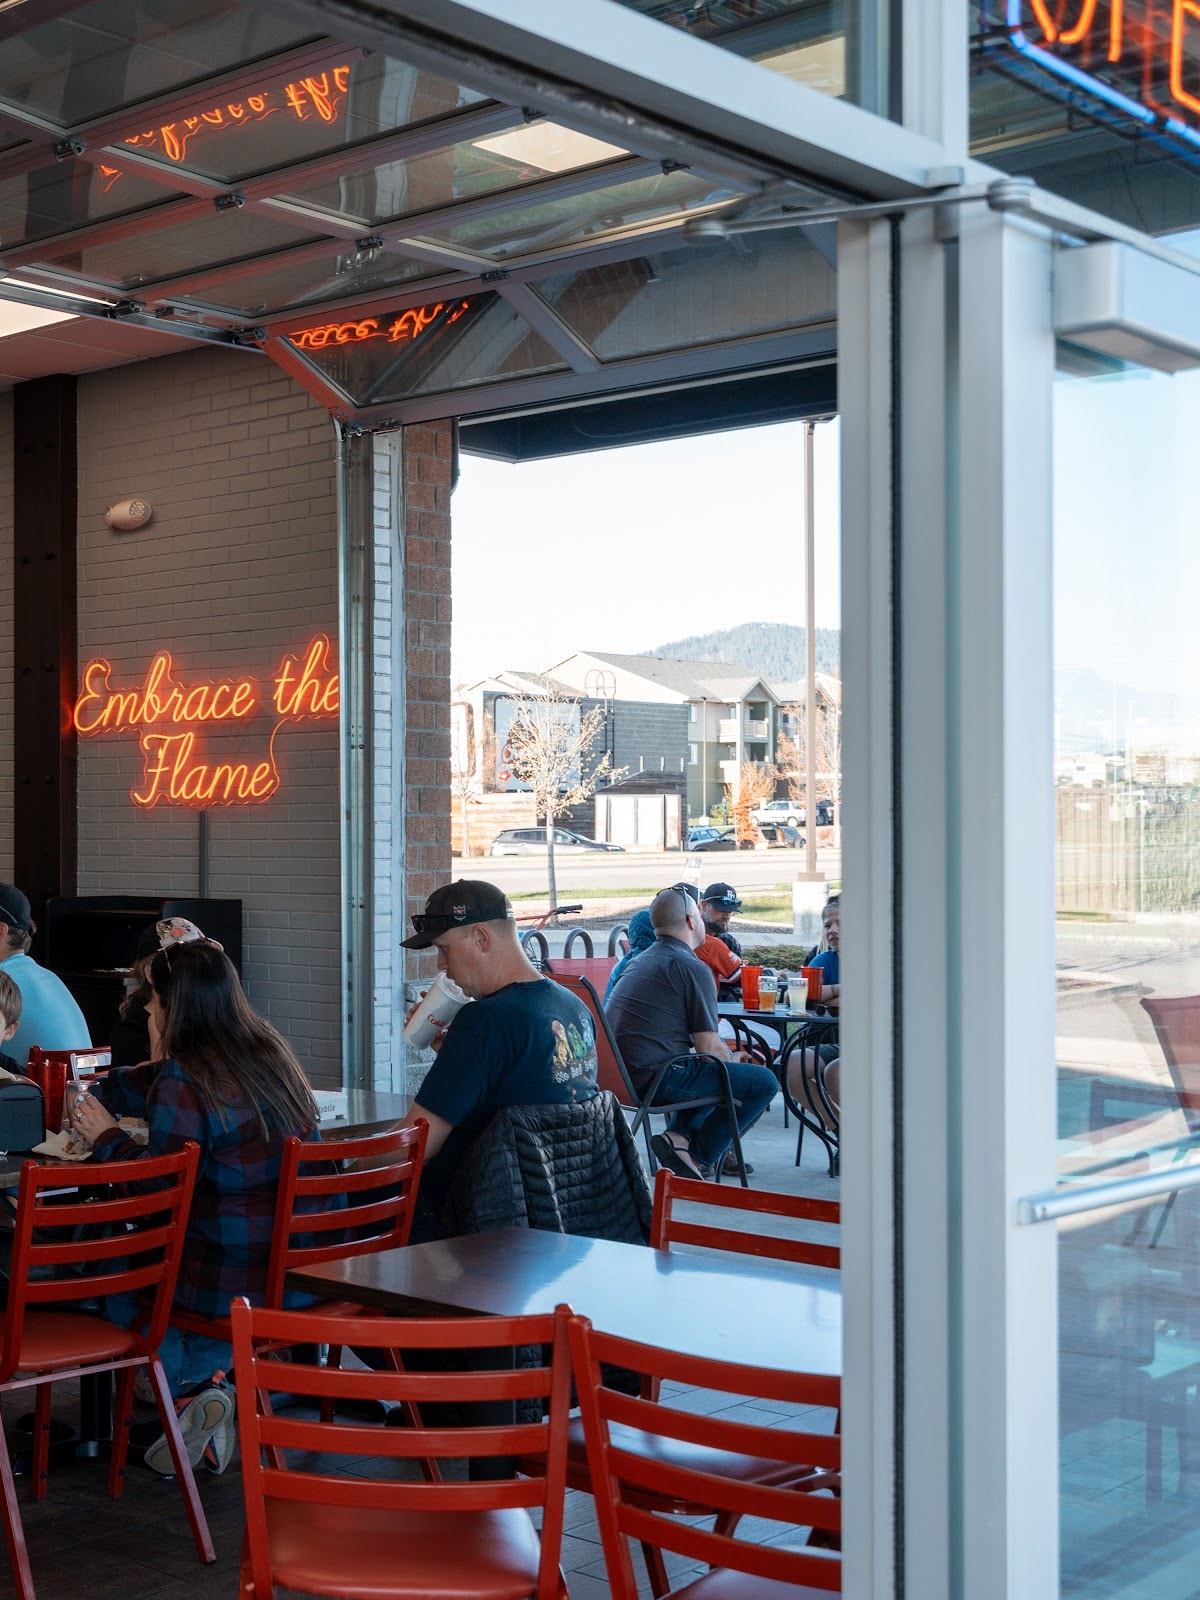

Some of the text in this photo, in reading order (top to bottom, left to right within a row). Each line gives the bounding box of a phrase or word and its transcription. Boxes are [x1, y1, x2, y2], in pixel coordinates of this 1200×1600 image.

[74, 640, 340, 731] Embrace the
[134, 732, 274, 803] Flame
